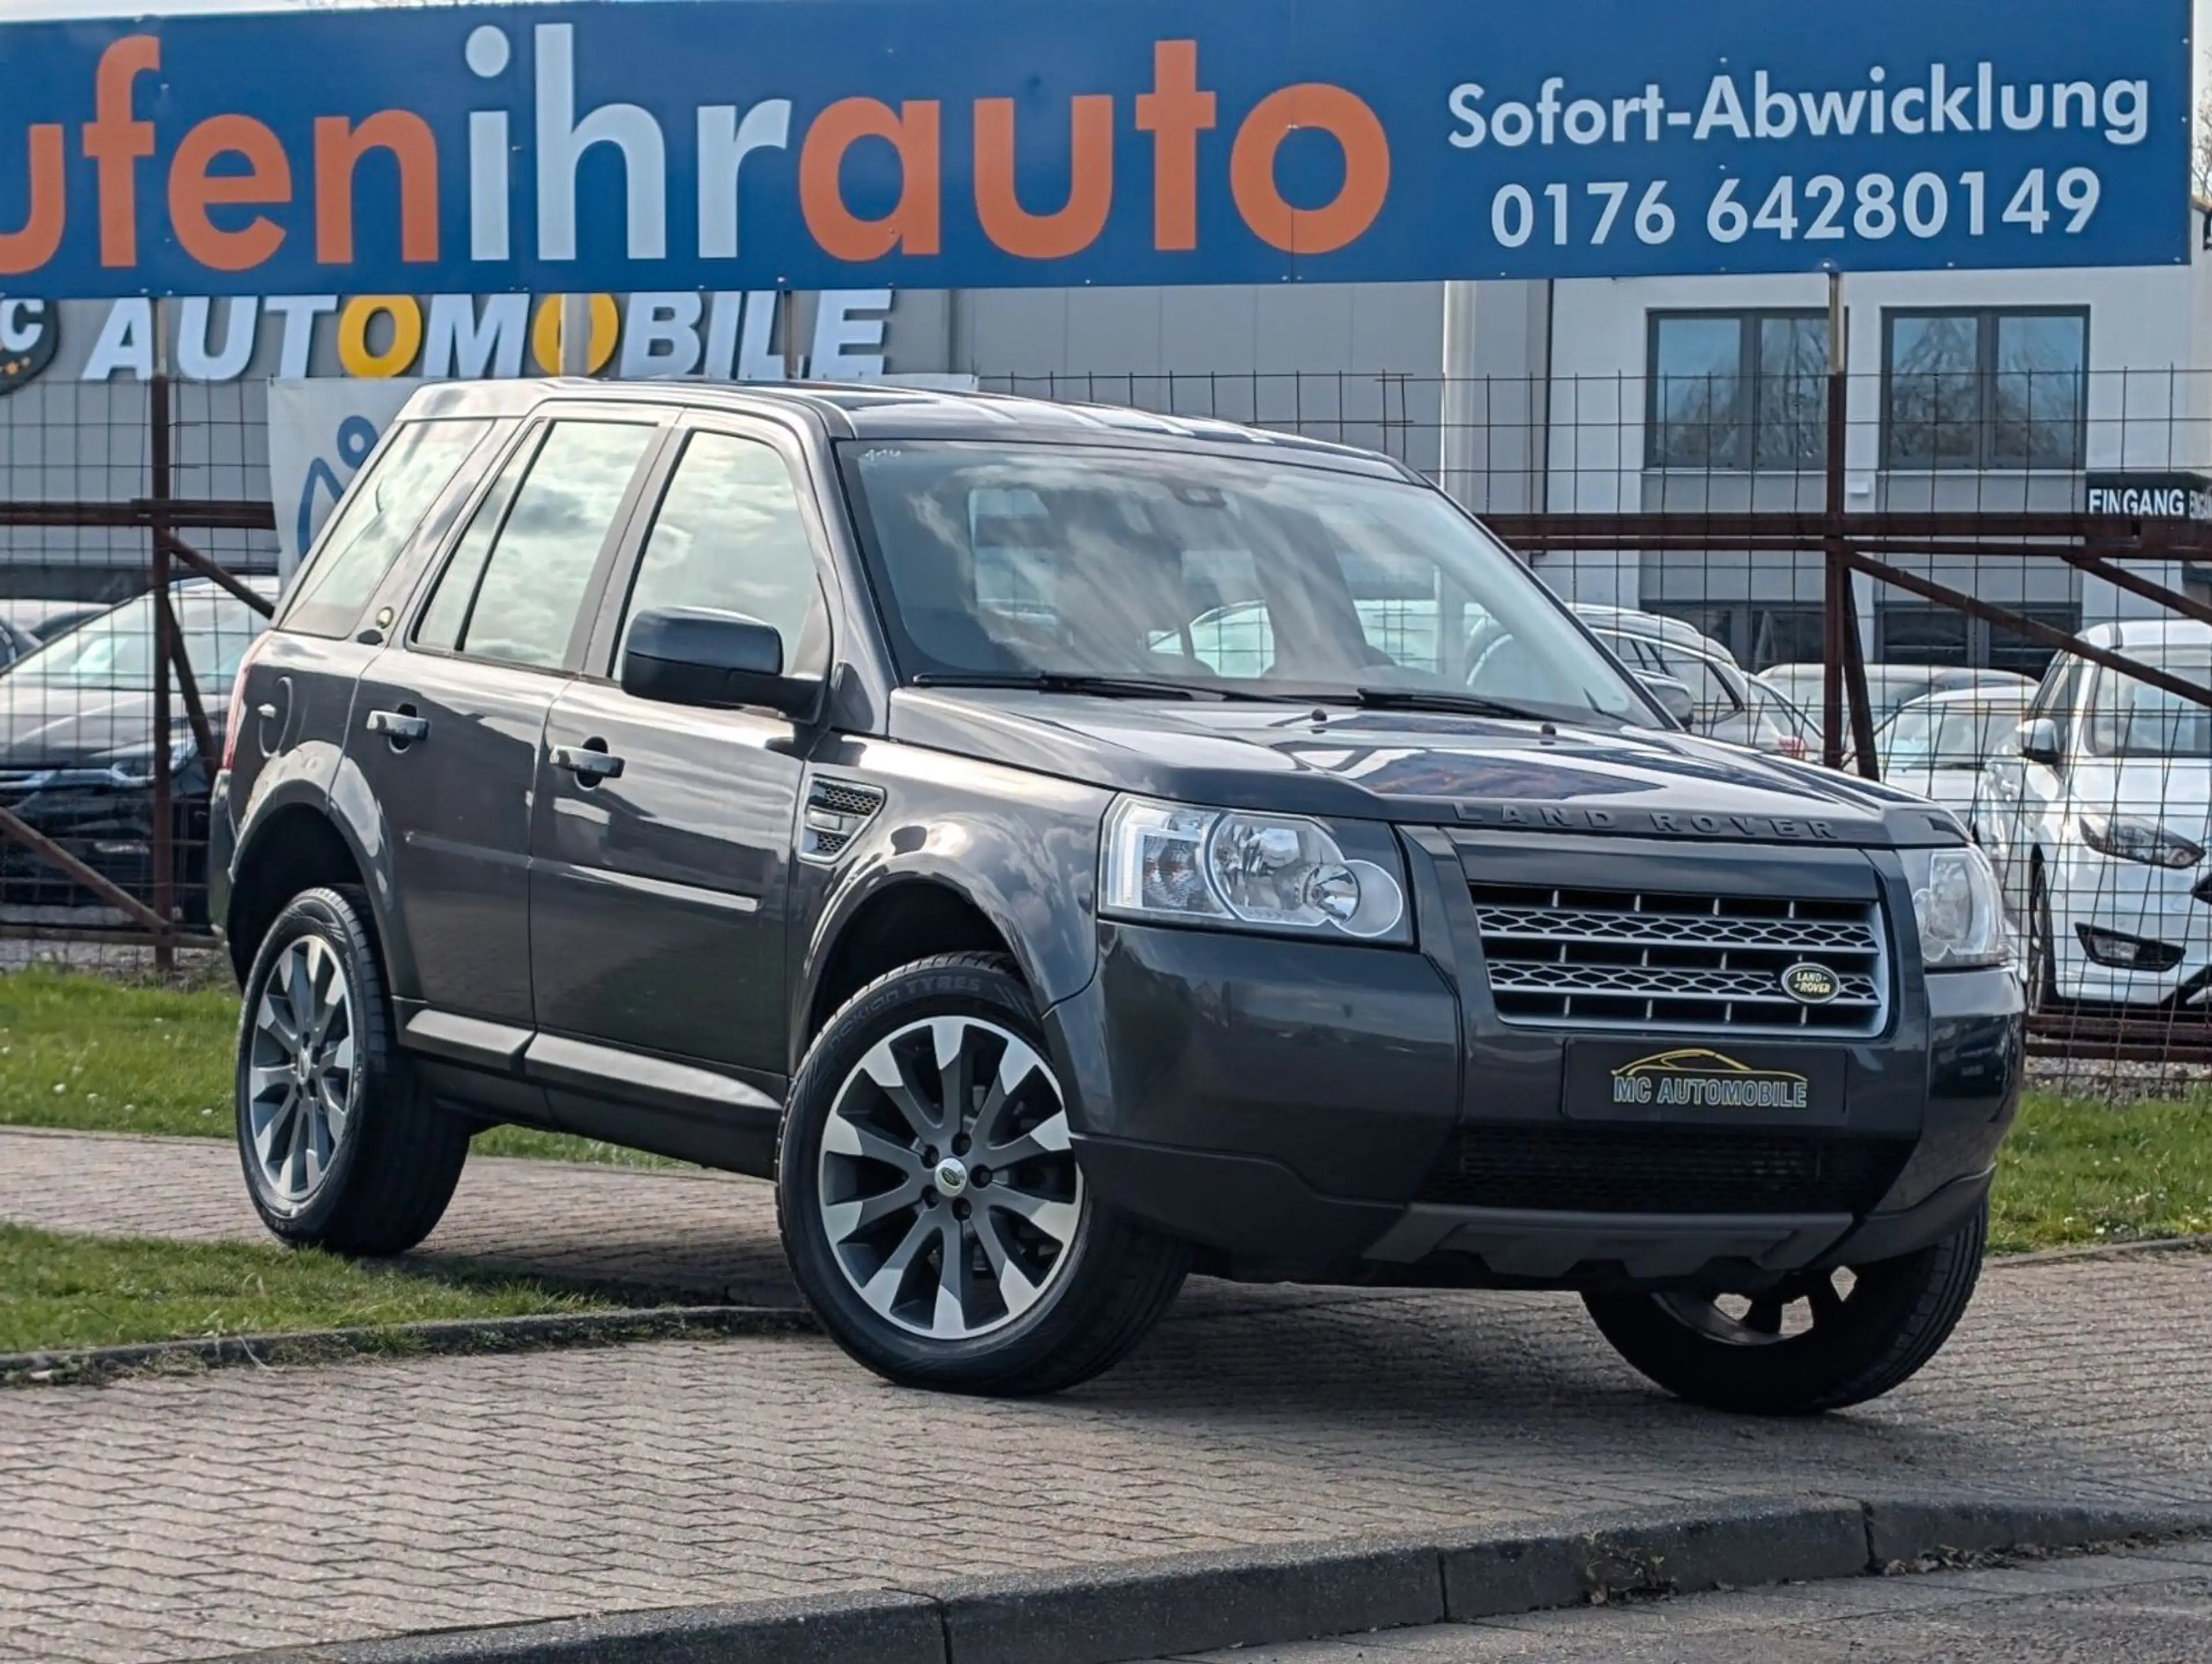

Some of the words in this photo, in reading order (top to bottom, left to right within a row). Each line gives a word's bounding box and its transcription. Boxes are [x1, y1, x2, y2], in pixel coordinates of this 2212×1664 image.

[1449, 62, 2148, 148] Sofort-Abwicklung
[1492, 180, 1675, 247] 0176
[1707, 168, 2100, 244] 64280149
[81, 289, 893, 381] AUTOMOBILE
[1453, 801, 1617, 829] LAND
[1648, 812, 1833, 839] ROVER
[905, 975, 983, 995] TYRES
[1796, 972, 1823, 982] LAND
[1799, 982, 1831, 993] ROVER
[1613, 1076, 1653, 1104] MC
[1656, 1077, 1808, 1108] AUTOMOBILE
